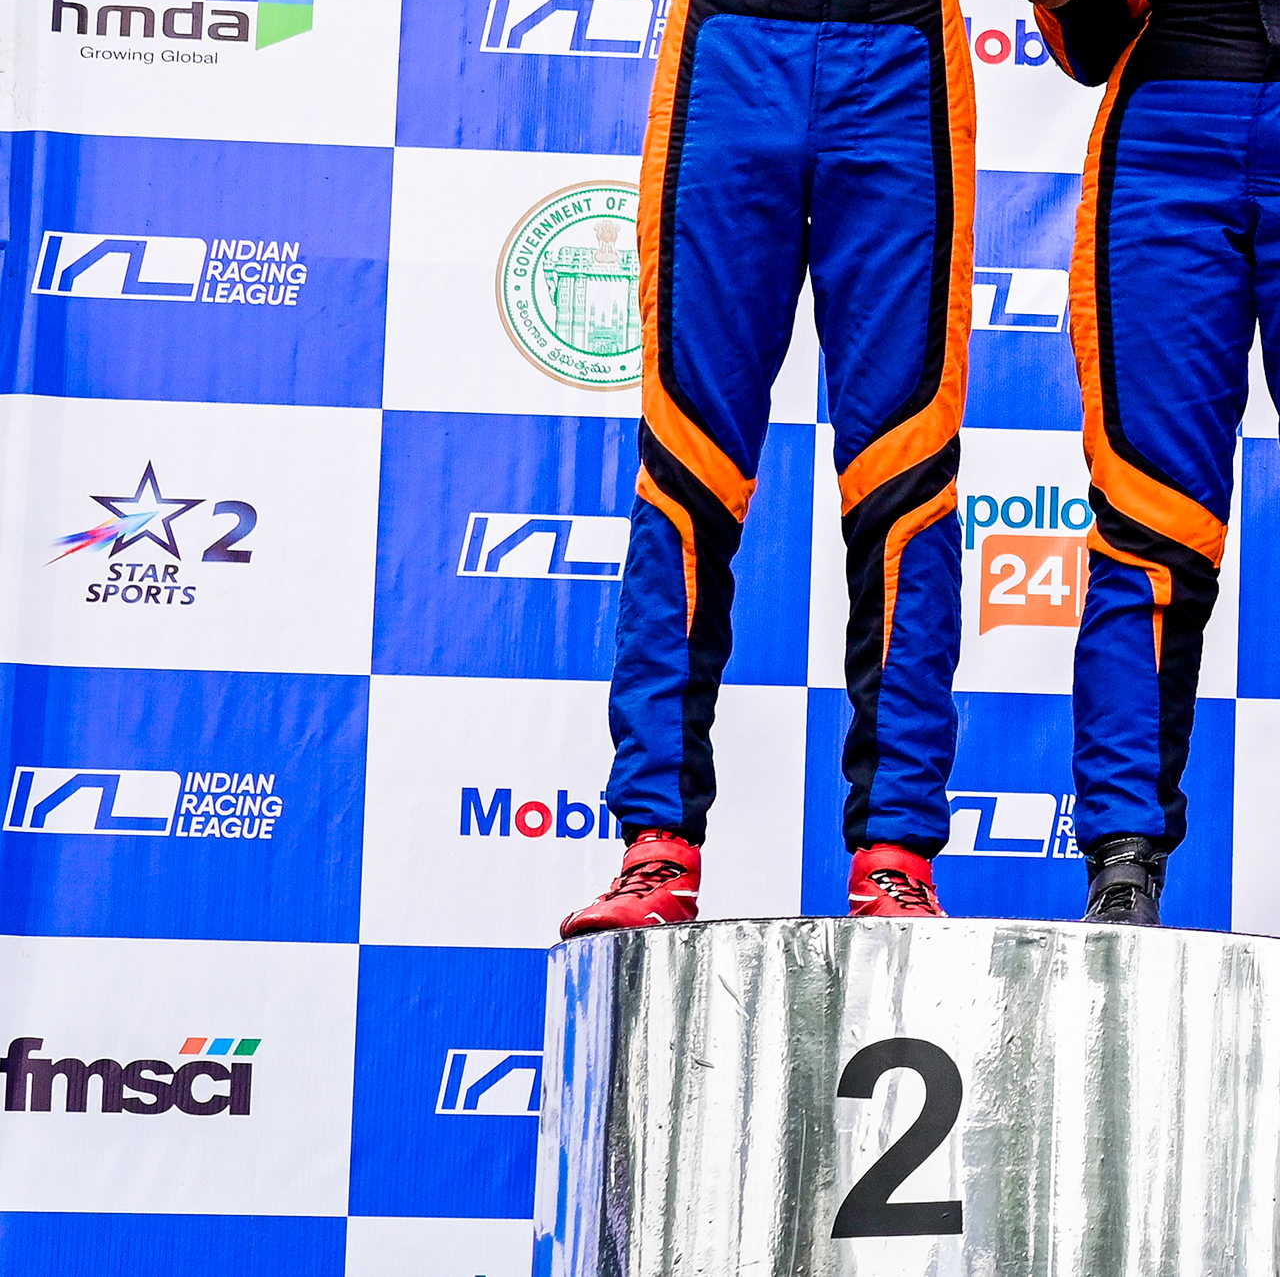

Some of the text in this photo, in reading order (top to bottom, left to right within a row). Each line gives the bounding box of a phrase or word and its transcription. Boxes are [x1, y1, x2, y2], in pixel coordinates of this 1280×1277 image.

[80, 45, 219, 65] Growing Global
[515, 197, 627, 277] GOVERNMENT OF
[210, 239, 300, 262] INDIAN
[206, 260, 307, 285] RACING
[201, 282, 299, 306] LEAGUE
[963, 486, 1092, 549] pollo
[202, 501, 258, 563] 2
[106, 562, 180, 584] STAR
[86, 582, 196, 607] SPORTS
[184, 772, 275, 795] INDIAN
[180, 793, 282, 819] RACING
[175, 816, 273, 840] LEAGUE
[831, 1037, 964, 1238] 2
